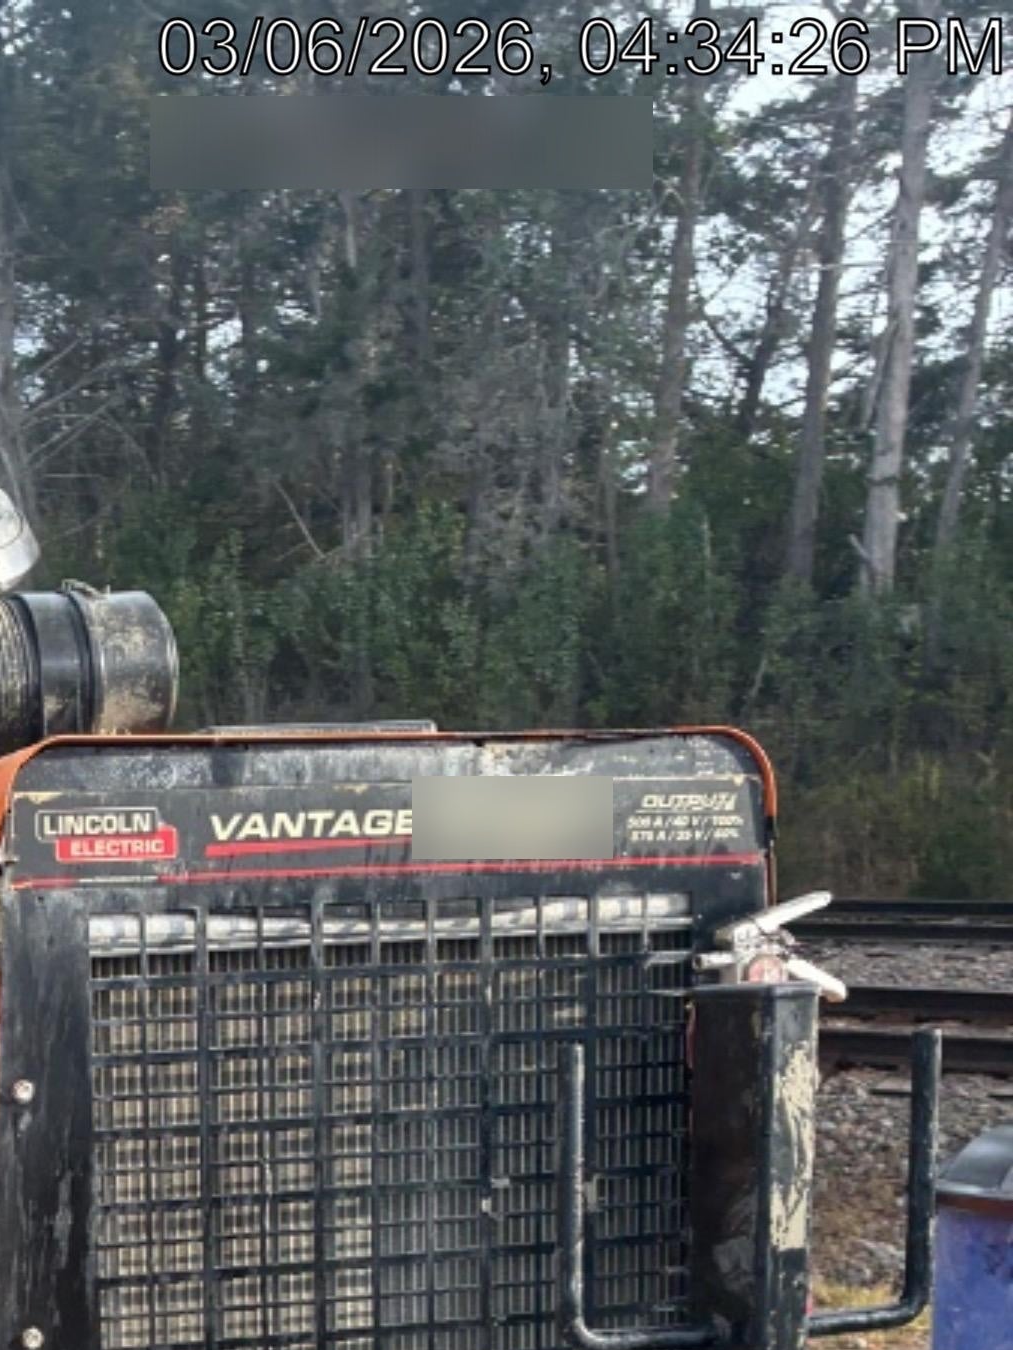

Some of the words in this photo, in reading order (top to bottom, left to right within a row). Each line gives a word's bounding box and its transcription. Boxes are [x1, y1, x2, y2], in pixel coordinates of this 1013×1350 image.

[42, 811, 152, 836] LINCOLN
[210, 808, 413, 842] VANTAGE
[70, 837, 166, 857] ELECTRIC
